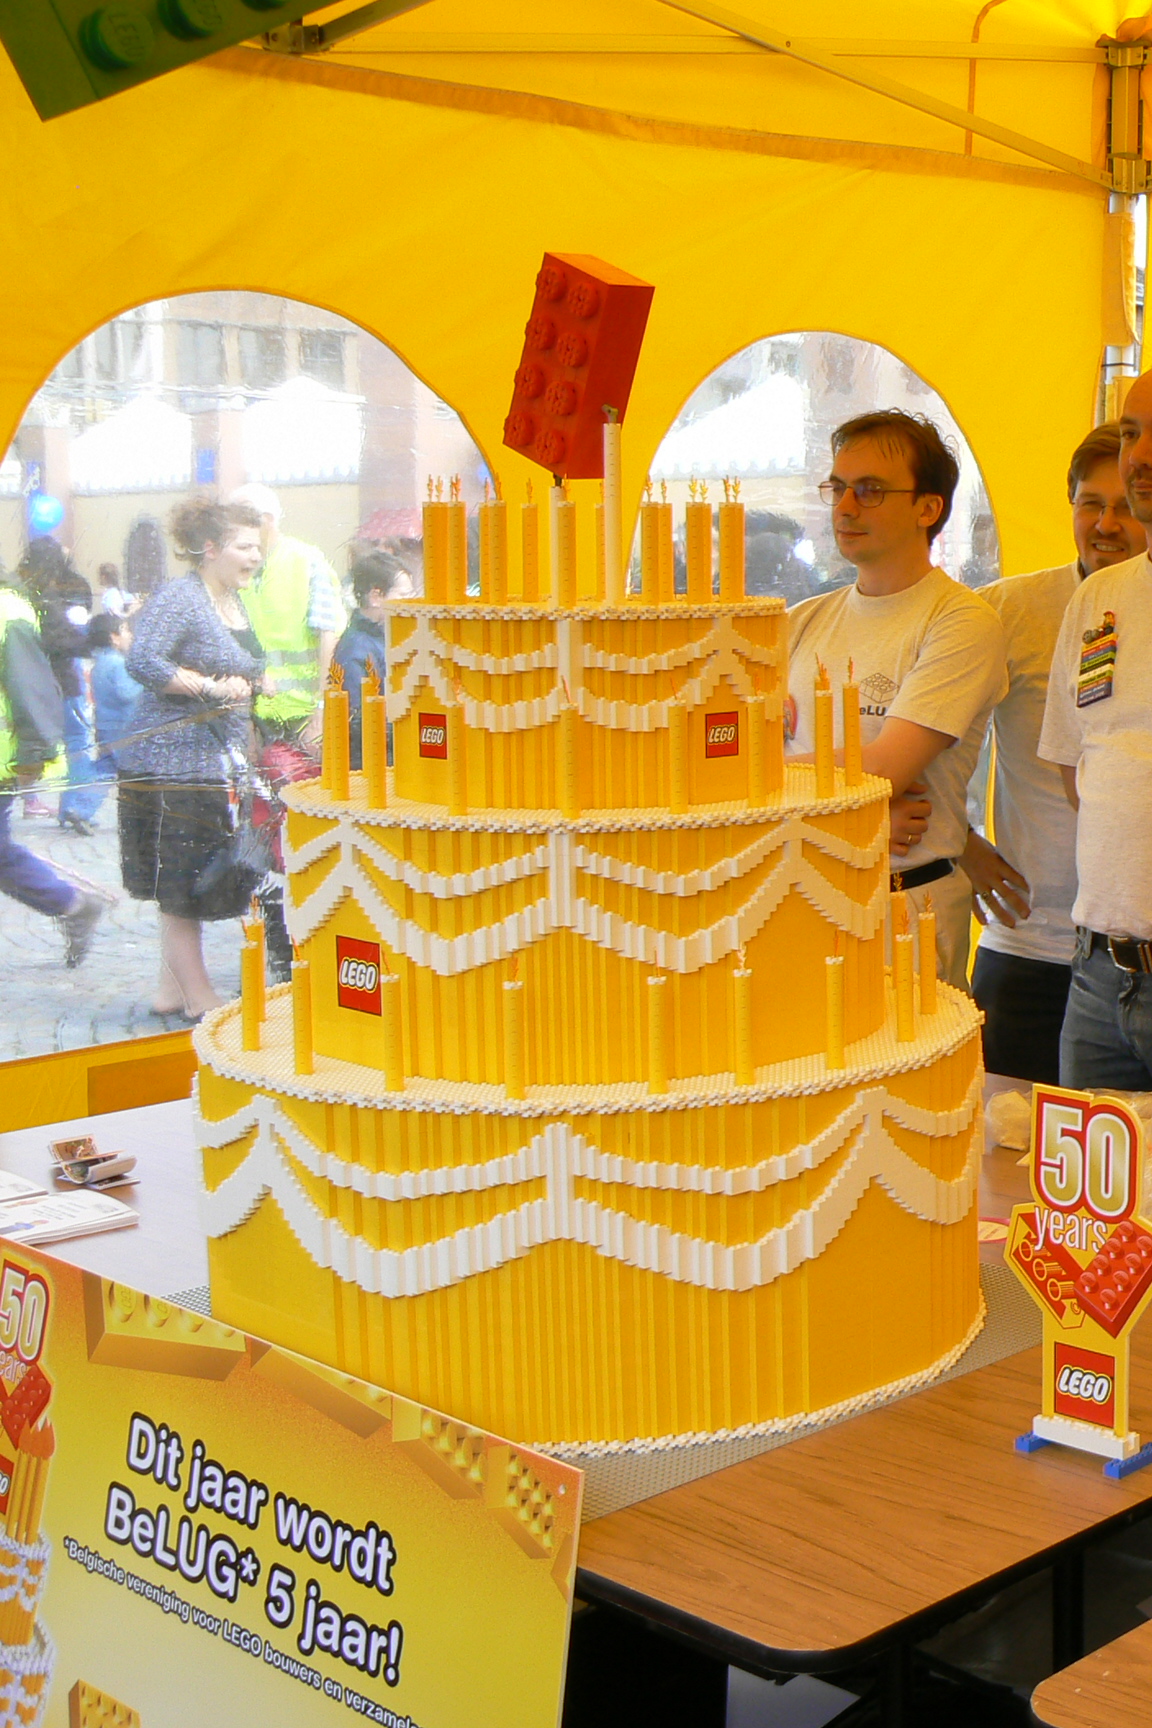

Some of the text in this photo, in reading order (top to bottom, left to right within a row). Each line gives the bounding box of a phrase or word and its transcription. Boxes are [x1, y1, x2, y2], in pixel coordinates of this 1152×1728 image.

[708, 726, 736, 744] LEGO
[859, 705, 887, 717] eLU
[421, 727, 444, 745] LEGO
[340, 959, 377, 991] LEGO
[1040, 1102, 1131, 1217] 50
[1034, 1206, 1108, 1254] years
[0, 1267, 46, 1361] 50
[1057, 1366, 1110, 1403] LEGO
[127, 1412, 396, 1594] Dit jaar wordt
[126, 1571, 191, 1623] vereniging
[191, 1606, 222, 1635] voor
[223, 1618, 262, 1656] LEGO
[264, 1641, 322, 1690] bouwers
[324, 1677, 343, 1701] en
[265, 1563, 295, 1627] 5
[299, 1578, 402, 1686] jaar!
